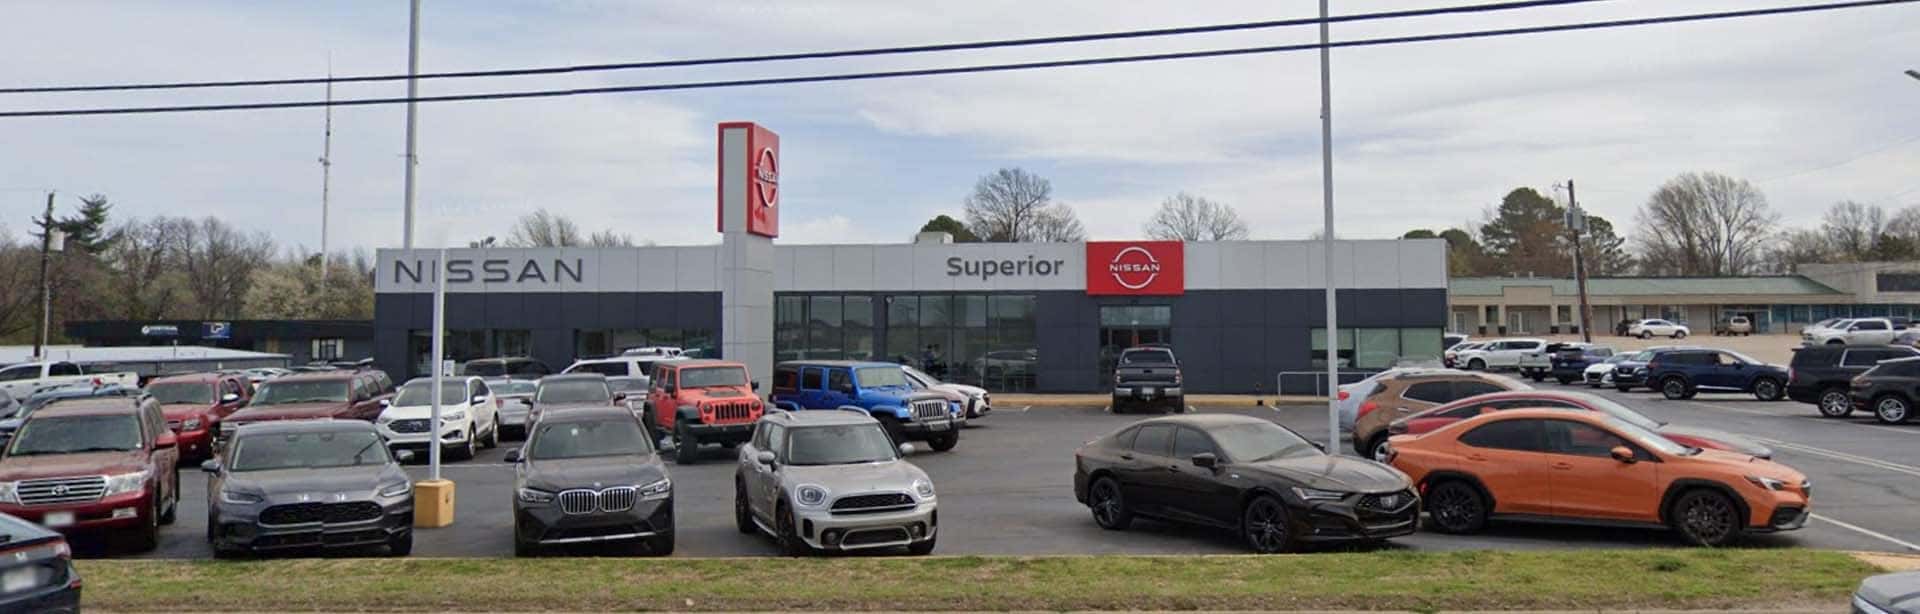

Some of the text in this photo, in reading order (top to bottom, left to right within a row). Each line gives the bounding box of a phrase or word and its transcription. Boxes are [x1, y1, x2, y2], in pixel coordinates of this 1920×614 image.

[395, 259, 582, 283] NISSAN
[947, 255, 1065, 280] Superior
[1110, 263, 1160, 272] NISSAN
